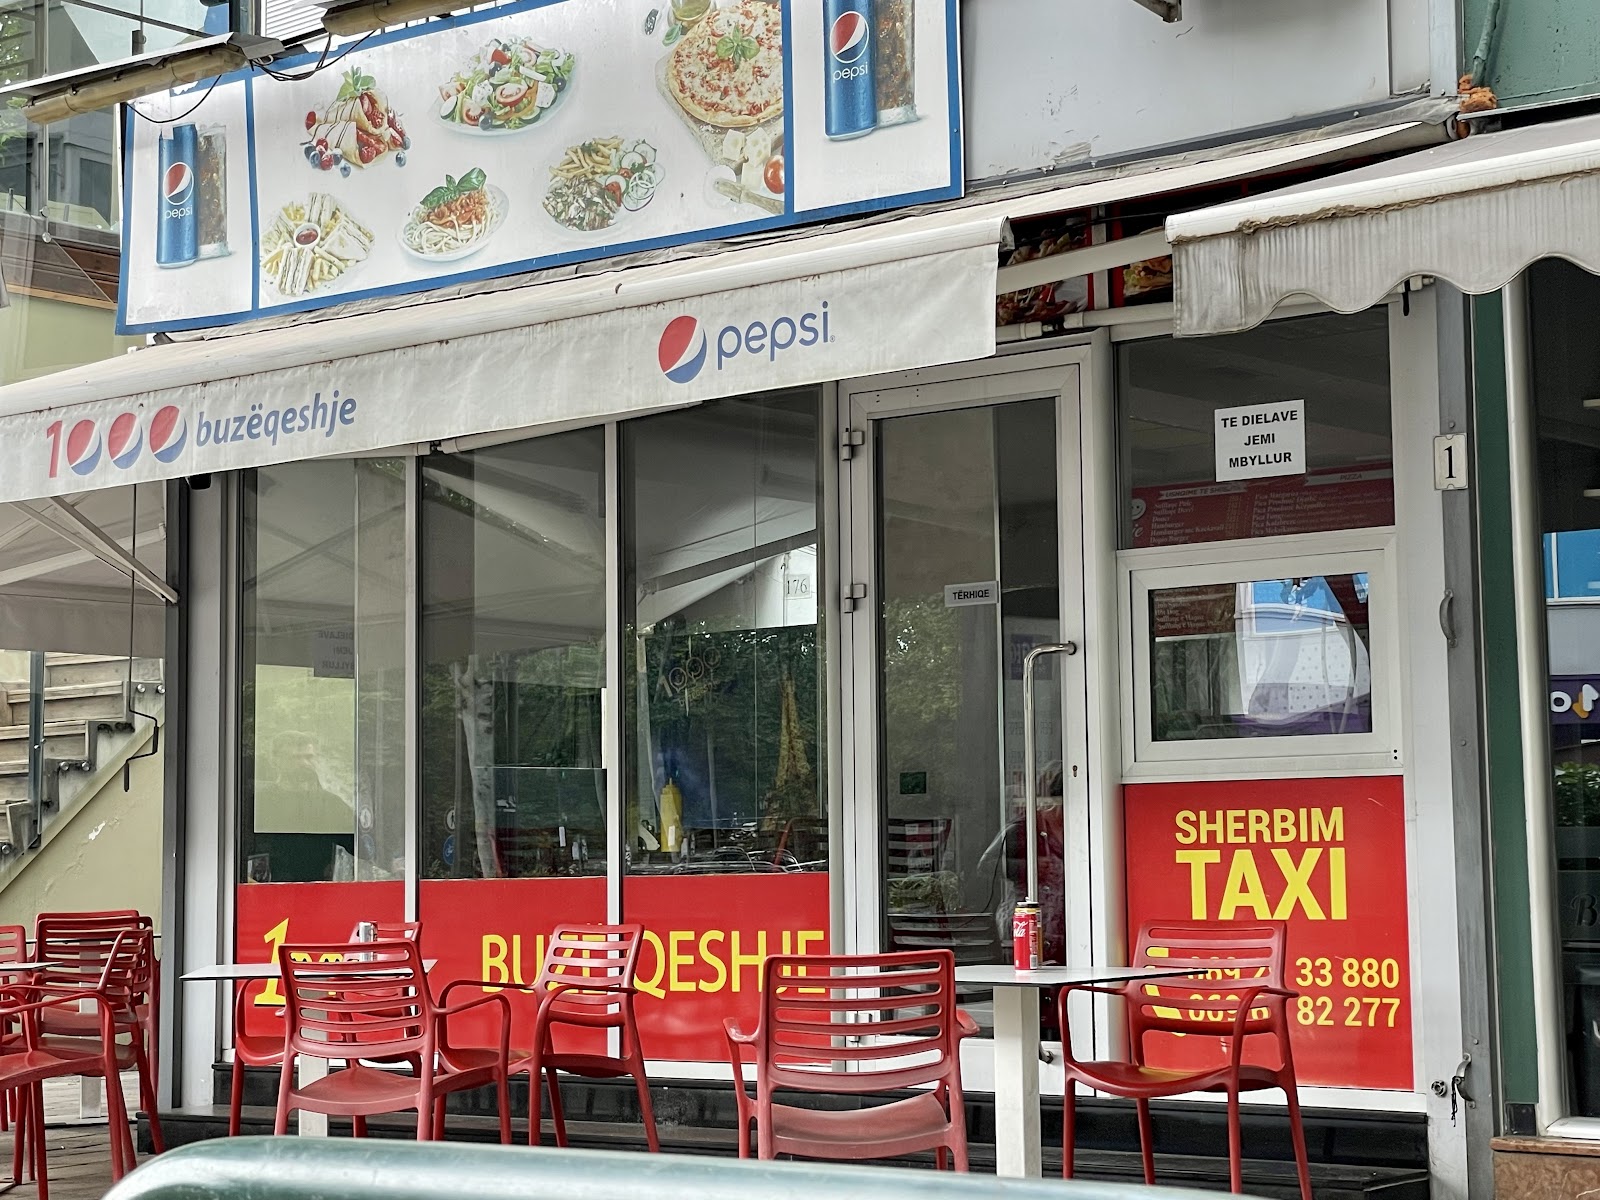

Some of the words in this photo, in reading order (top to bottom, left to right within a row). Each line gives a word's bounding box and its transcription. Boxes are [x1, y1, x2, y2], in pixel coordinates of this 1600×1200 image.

[832, 61, 868, 83] pepsi
[164, 204, 193, 221] pepsi
[717, 300, 829, 371] pepsi
[196, 389, 357, 448] buzëqeshje
[1221, 416, 1238, 428] TE
[1241, 410, 1298, 426] DIELAVE
[1244, 433, 1276, 446] JEMI
[1229, 452, 1293, 468] MBYLLUR
[1443, 445, 1457, 480] 1
[787, 578, 808, 595] 176
[952, 589, 990, 601] TËRHIQE
[1175, 807, 1345, 845] SHERBIM
[1175, 847, 1348, 921] TAXI
[1295, 957, 1333, 987] 33
[1342, 958, 1400, 988] 880
[1297, 996, 1334, 1026] 82
[1344, 997, 1400, 1027] 277
